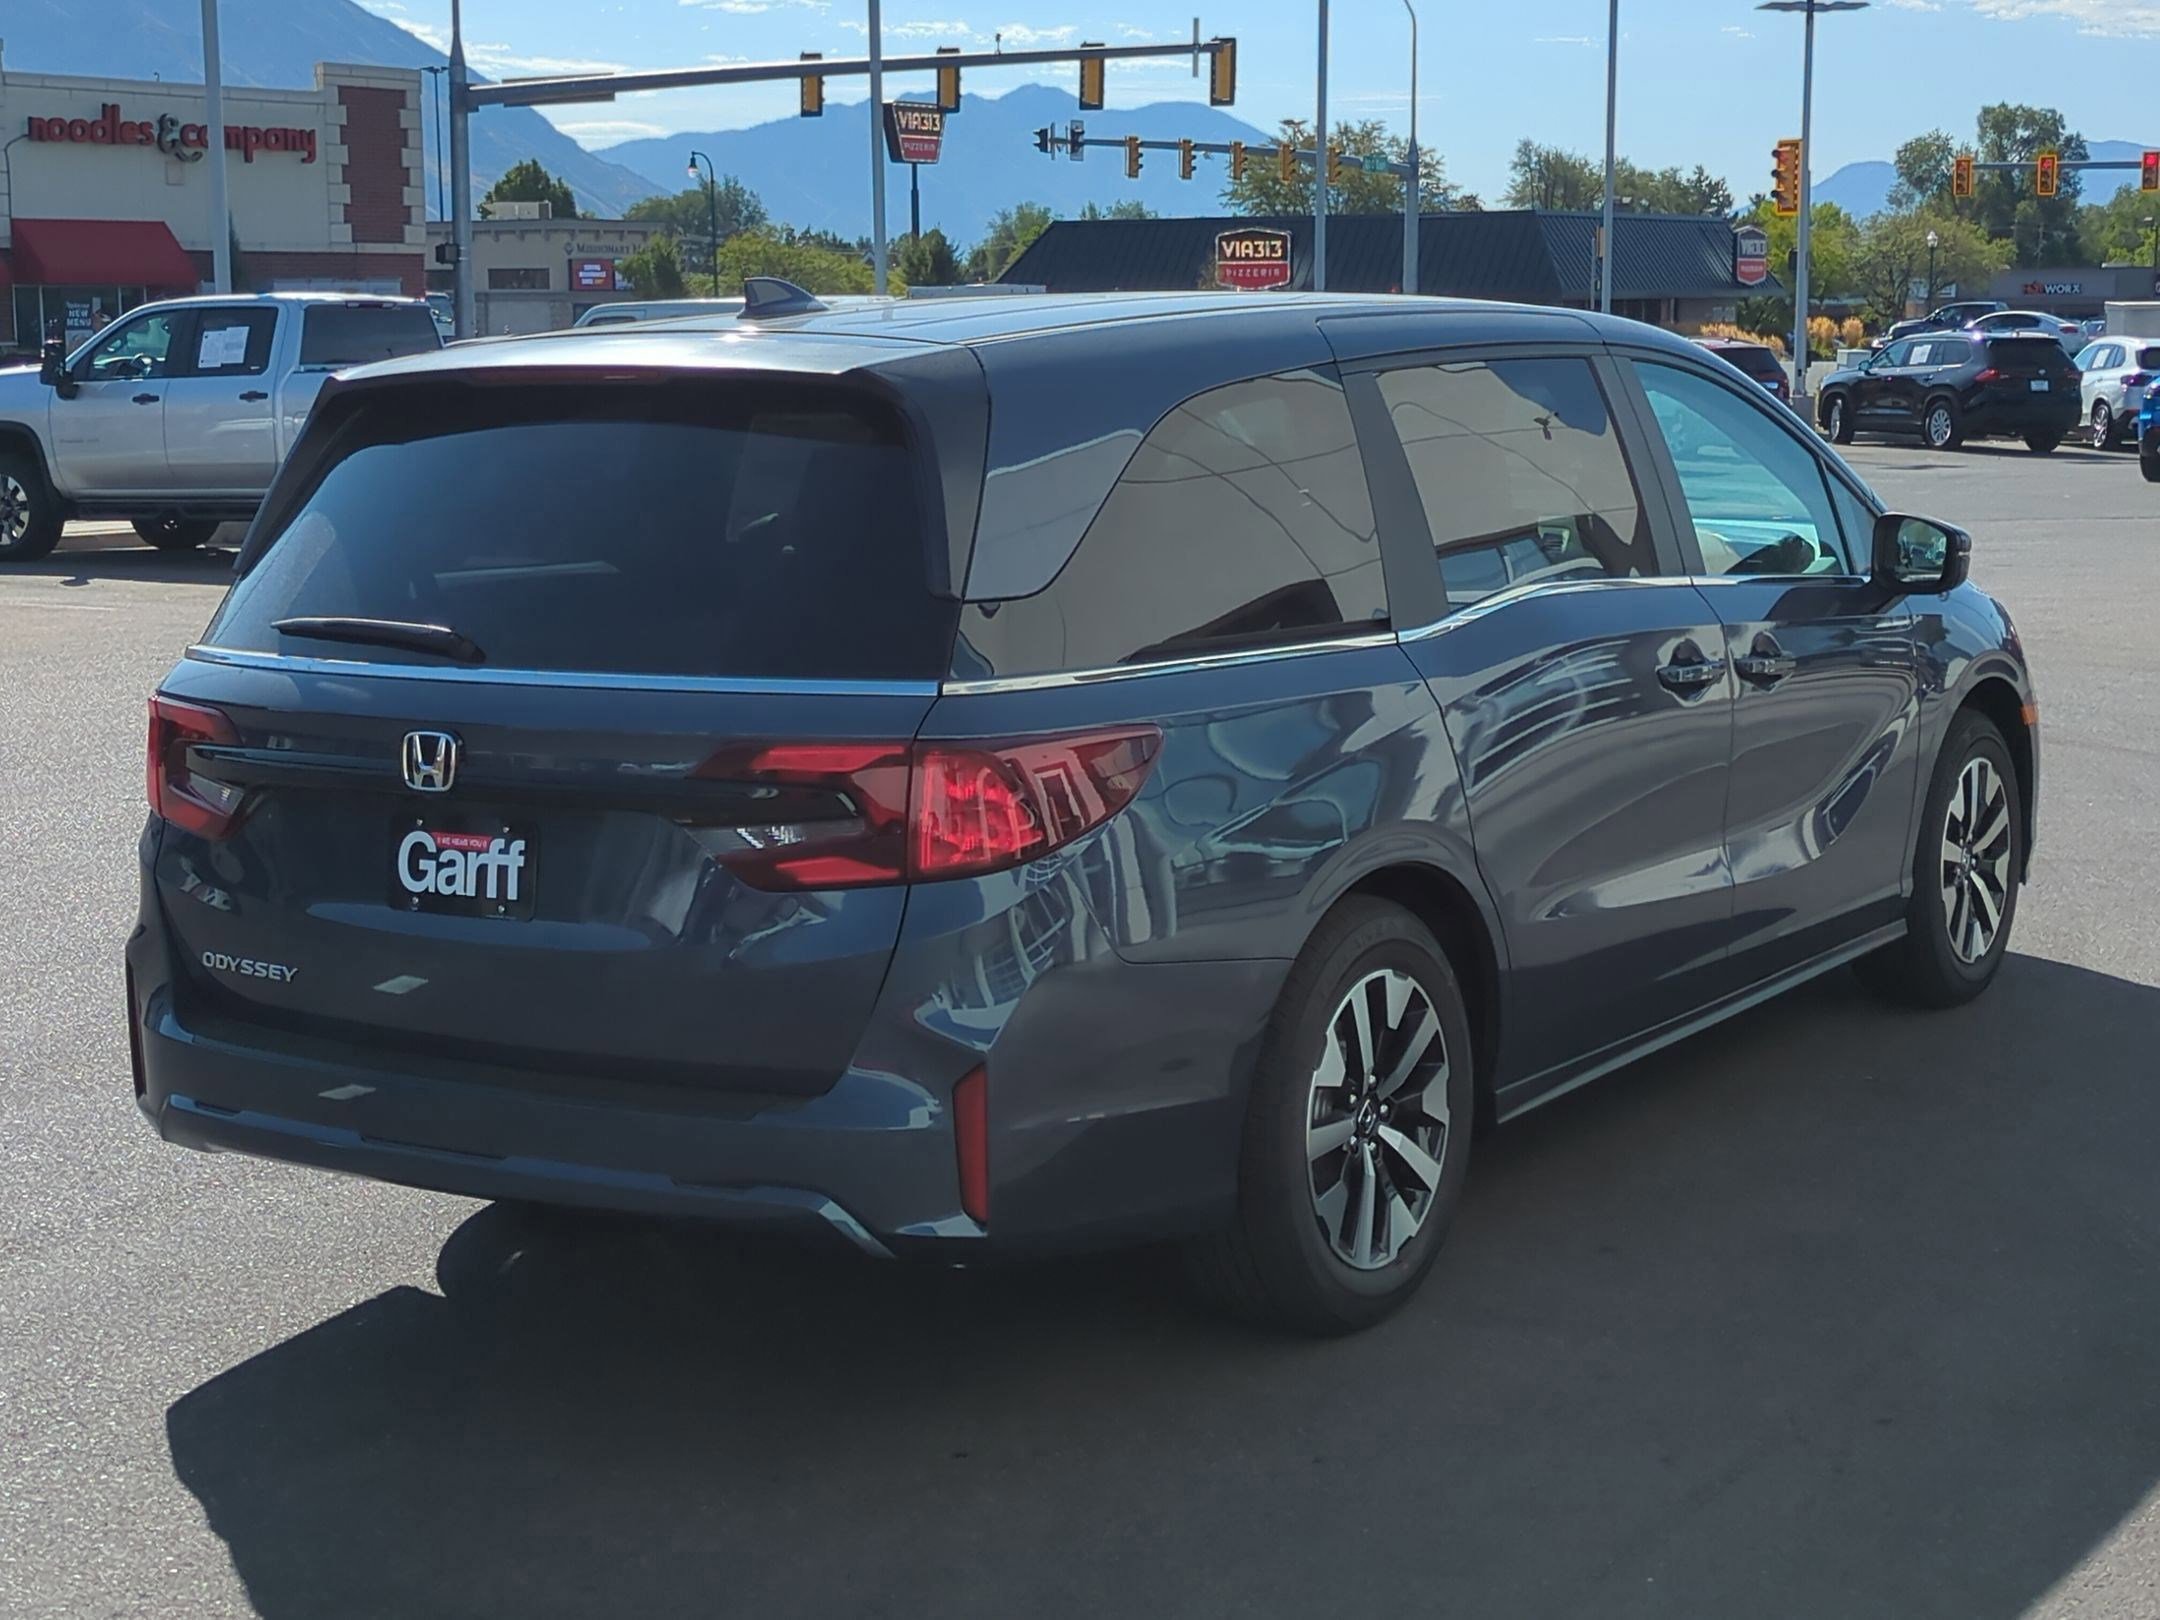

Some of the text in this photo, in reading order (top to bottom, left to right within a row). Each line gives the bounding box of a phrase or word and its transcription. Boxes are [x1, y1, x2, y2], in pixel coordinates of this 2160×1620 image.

[27, 103, 155, 145] noodles
[398, 831, 526, 900] Garff
[202, 951, 298, 982] ODYSSEY
